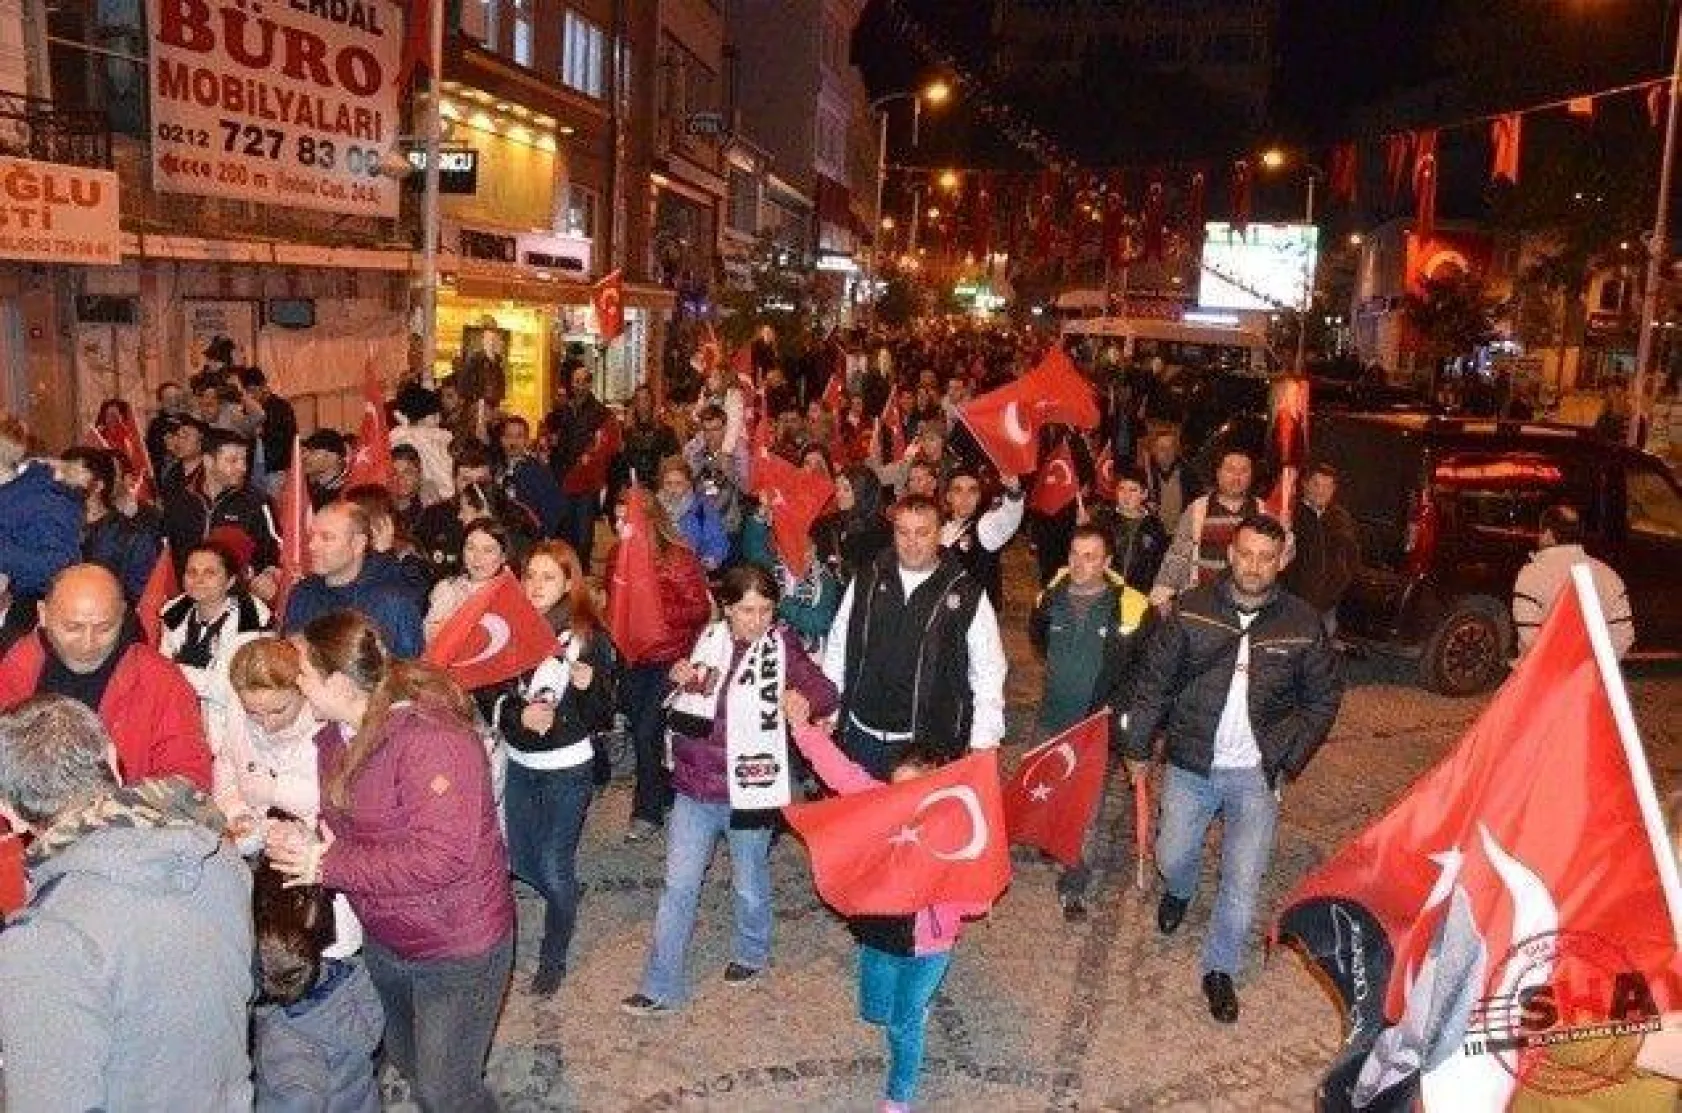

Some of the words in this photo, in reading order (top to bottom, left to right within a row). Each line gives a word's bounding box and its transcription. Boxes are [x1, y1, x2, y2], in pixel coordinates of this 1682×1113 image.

[156, 0, 382, 96] BÜRO
[158, 123, 210, 148] 0212
[219, 119, 284, 159] 727
[298, 134, 335, 169] 83
[761, 637, 779, 731] KART
